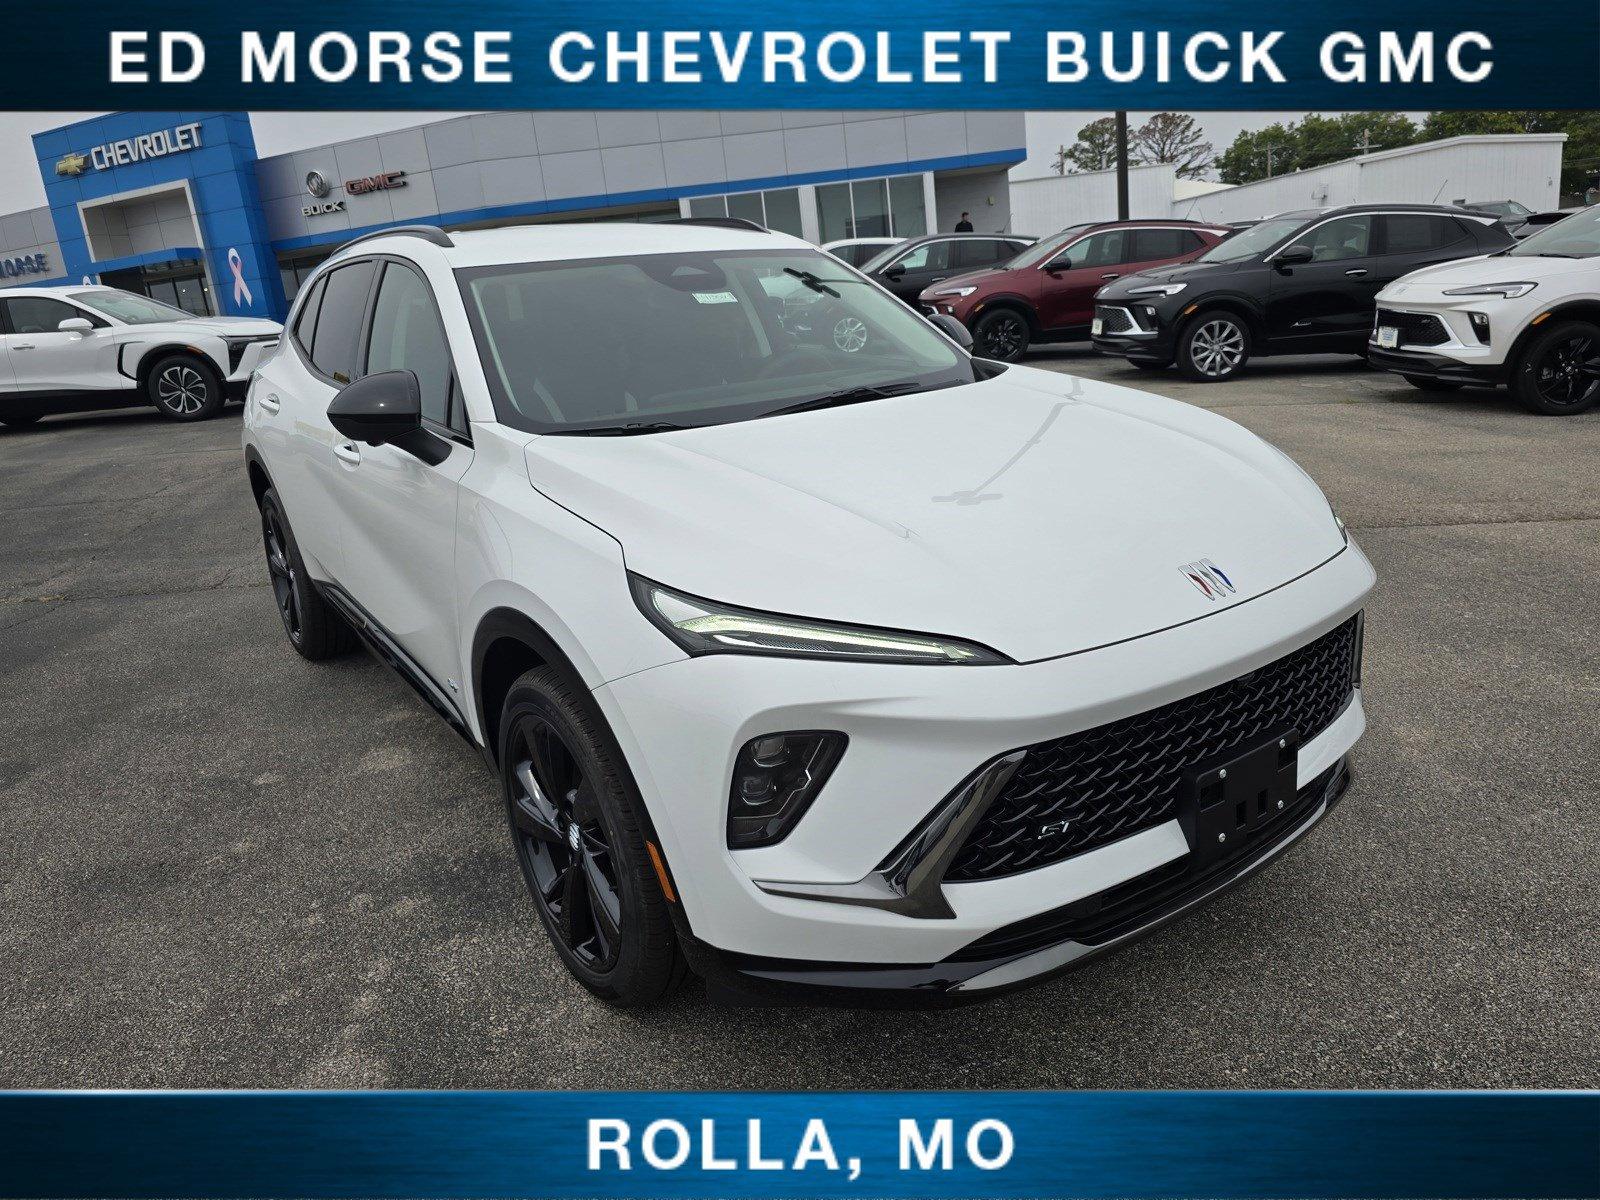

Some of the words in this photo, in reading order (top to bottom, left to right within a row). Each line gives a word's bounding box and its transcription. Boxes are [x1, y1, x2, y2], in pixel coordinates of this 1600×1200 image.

[90, 121, 203, 171] CHEVROLET
[345, 171, 408, 196] GMC
[301, 200, 347, 218] BUICK
